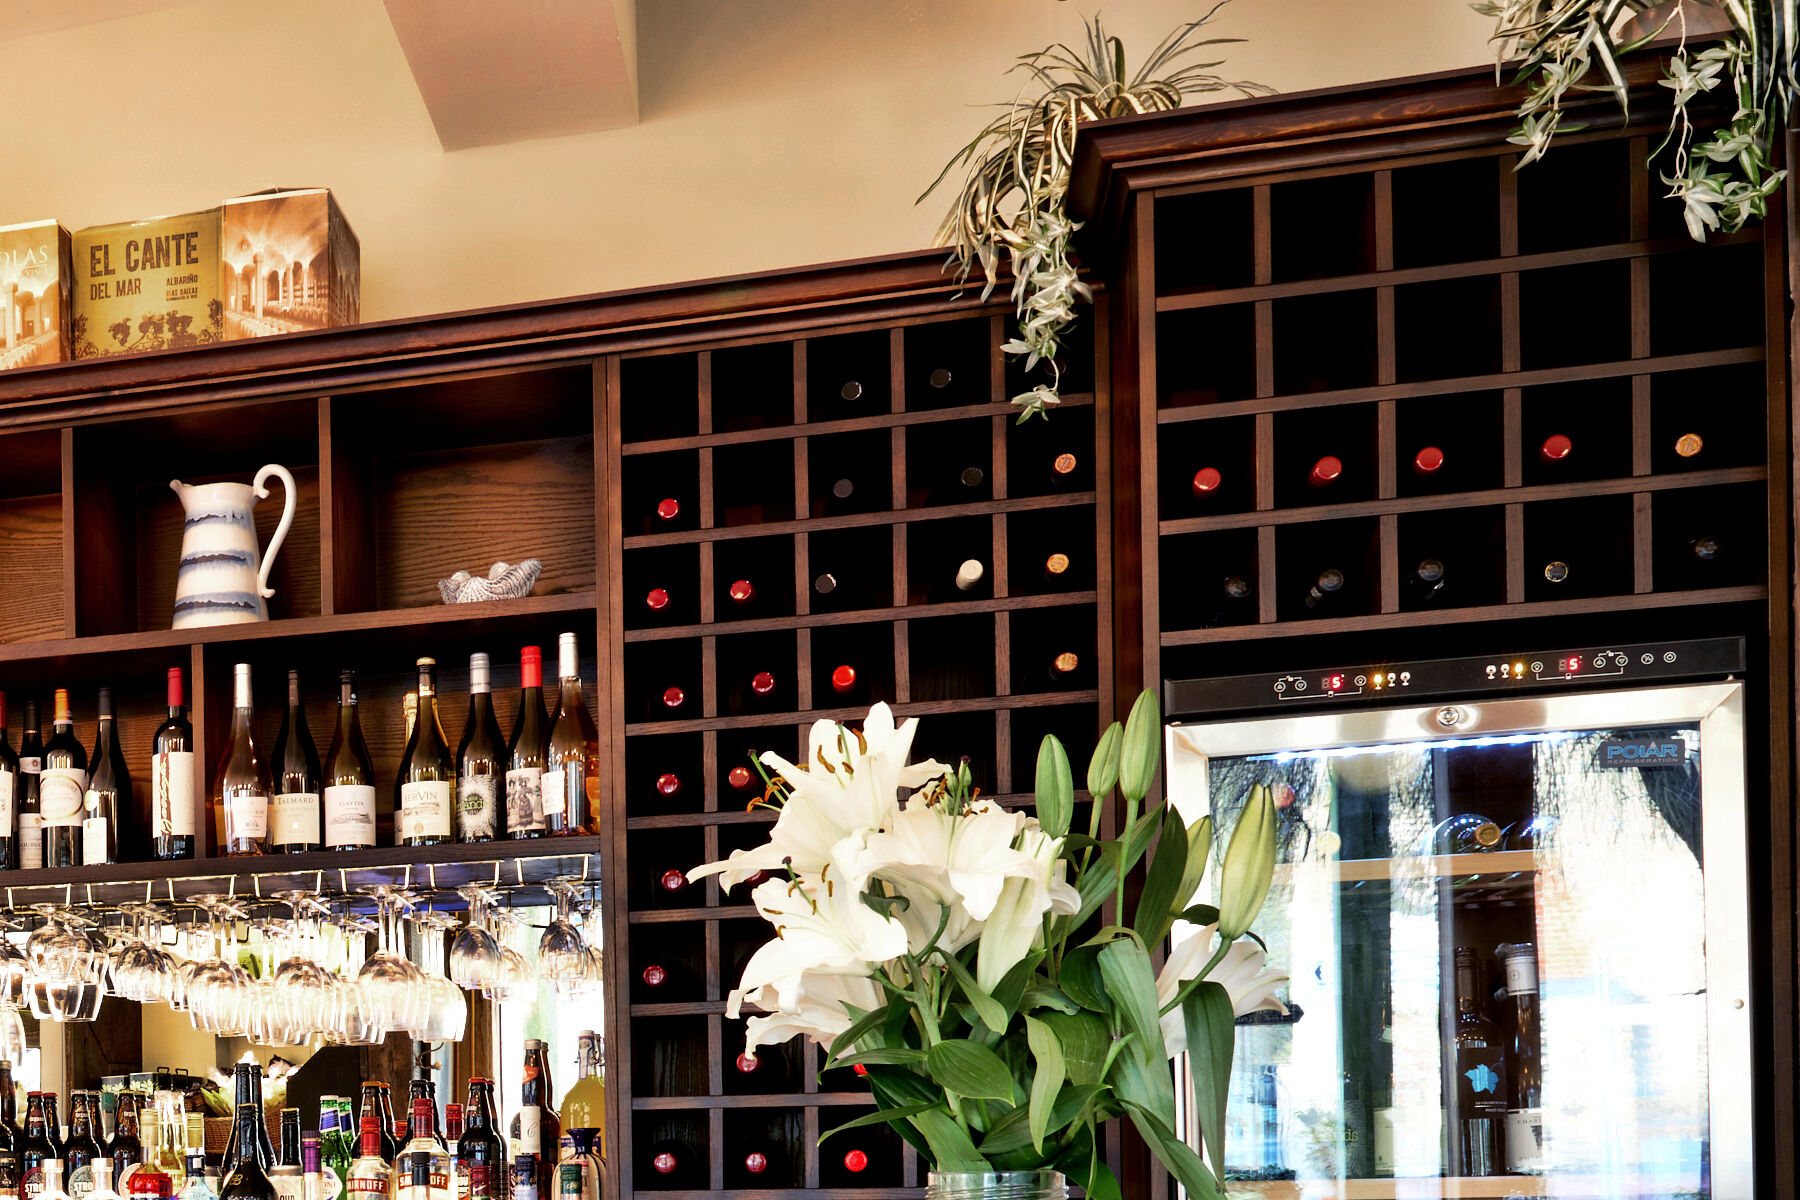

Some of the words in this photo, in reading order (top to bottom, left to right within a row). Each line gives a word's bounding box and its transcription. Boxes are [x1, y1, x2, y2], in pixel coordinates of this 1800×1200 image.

[91, 244, 115, 278] EL
[125, 231, 199, 272] CANTE
[166, 274, 198, 286] ALBARIÑO
[90, 282, 111, 300] DEL
[116, 278, 141, 297] MAR
[1607, 741, 1678, 759] POLAR
[277, 797, 314, 805] TALMARD
[73, 1181, 93, 1191] STRO
[399, 1174, 446, 1187] SMOFF
[24, 1183, 44, 1192] STRO
